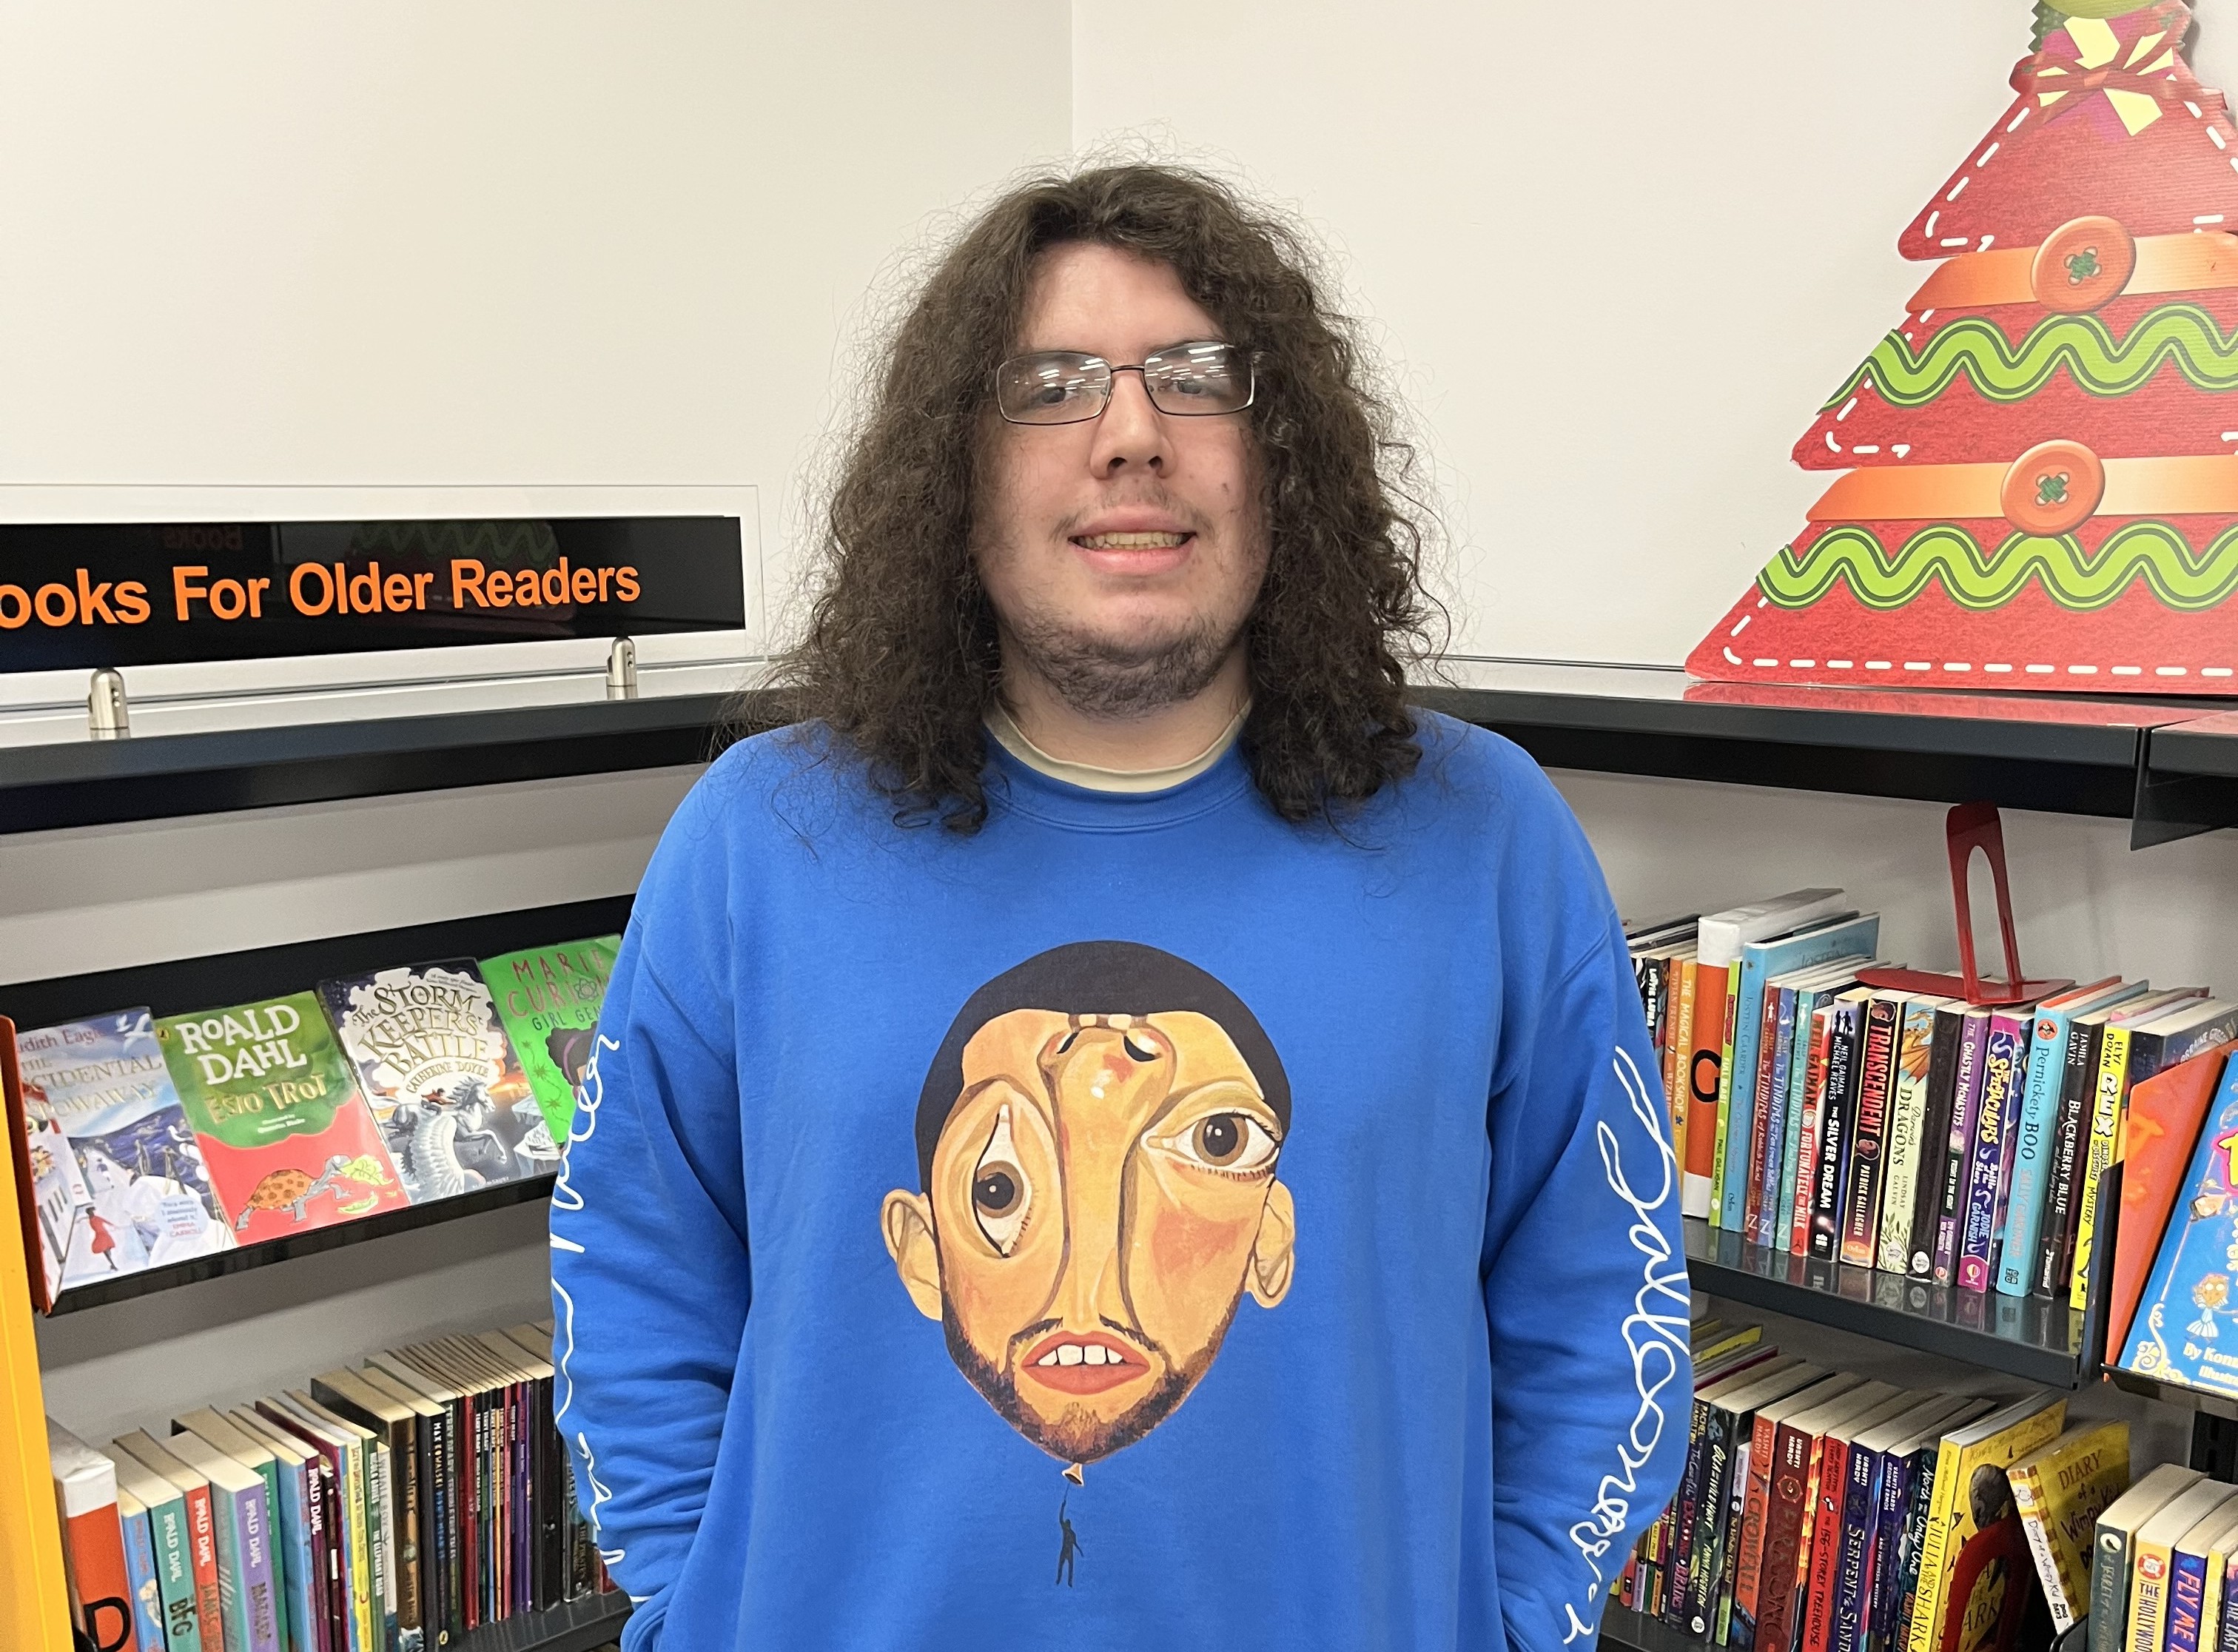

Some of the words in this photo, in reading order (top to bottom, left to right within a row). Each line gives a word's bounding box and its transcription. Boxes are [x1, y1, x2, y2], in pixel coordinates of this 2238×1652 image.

[173, 565, 269, 622] For
[292, 560, 435, 619] Older
[451, 557, 641, 609] Readers
[511, 948, 605, 982] MARIE
[1648, 969, 1658, 996] LOTTIE
[352, 1005, 381, 1027] The
[374, 982, 482, 1015] STORM
[1681, 979, 1691, 996] THE
[175, 1004, 300, 1055] ROALD
[531, 1011, 568, 1031] GIRL
[1647, 998, 1656, 1027] LUNA
[1678, 1003, 1690, 1047] MAGICAL
[1741, 996, 1754, 1031] JOSTEIN
[1810, 1019, 1823, 1050] NEIL
[1966, 1023, 1976, 1038] THE
[197, 1038, 309, 1086] DAHL
[382, 1032, 491, 1081] BATTLE
[1721, 1057, 1730, 1075] FULL
[1738, 1035, 1750, 1075] GAARDER
[1832, 1036, 1842, 1070] MICHAEL
[1840, 1044, 1848, 1062] NEIL
[1960, 1041, 1976, 1081] GHASTLY
[2067, 1031, 2080, 1066] GAVIN
[2077, 1032, 2089, 1067] JAMILA
[2102, 1032, 2114, 1067] DOLAN
[2113, 1041, 2123, 1065] ELYS
[406, 1061, 453, 1094] CATHERINE
[457, 1061, 489, 1078] DOYLE
[1674, 1054, 1687, 1112] BOOKSHOP
[1719, 1077, 1728, 1104] BLAST
[1804, 1053, 1821, 1106] GAIMAN
[1829, 1071, 1838, 1101] REAVES
[1837, 1064, 1846, 1095] GAIMAN
[1858, 1024, 1892, 1138] TRANSCENDENT
[2002, 1070, 2011, 1083] THE
[2024, 1047, 2050, 1120] Pernickety
[205, 1092, 264, 1124] ESIO
[263, 1073, 328, 1111] TROT
[1758, 1073, 1770, 1119] TINDIMS
[1771, 1077, 1784, 1123] TINDIMS
[1790, 1079, 1803, 1127] TINDIMS
[1980, 1054, 2010, 1145] SPECTACULARS
[2093, 1071, 2120, 1138] REX
[1824, 1118, 1839, 1161] SILVER
[1892, 1087, 1912, 1166] DRAGONS
[1909, 1106, 1922, 1146] Darwin's
[2020, 1122, 2040, 1161] BOO
[2059, 1099, 2082, 1181] BLACKBERRY
[1713, 1158, 1721, 1191] GILLIGAN
[1858, 1164, 1870, 1195] PATRICK
[1987, 1163, 1998, 1190] Battle
[2089, 1144, 2101, 1181] DISGUISE
[1820, 1164, 1835, 1209] DREAM
[1891, 1175, 1899, 1206] GALVIN
[1899, 1175, 1908, 1209] LINDSAY
[2054, 1182, 2069, 1215] BLUE
[1794, 1206, 1807, 1229] MILK
[1853, 1195, 1866, 1237] GALLAGHER
[1967, 1201, 1981, 1243] GARNISH
[2083, 1186, 2095, 1225] MYSTERY
[1978, 1210, 1991, 1239] JODIE
[2182, 1342, 2202, 1361] By
[433, 1422, 441, 1443] MAX
[446, 1405, 454, 1437] TERRY
[1689, 1403, 1700, 1446] HAMILTON
[1697, 1405, 1707, 1437] RACHEL
[1753, 1424, 1764, 1455] HARDY
[1761, 1427, 1771, 1459] VASHTI
[1785, 1434, 1795, 1465] HARDY
[1793, 1437, 1803, 1469] VASHTI
[378, 1459, 388, 1499] WHALE
[434, 1443, 443, 1488] KOWALSKI
[1853, 1453, 1863, 1483] HARDY
[1860, 1456, 1870, 1487] VASHTI
[1885, 1462, 1893, 1488] GEORGE
[1919, 1465, 1935, 1501] North
[2058, 1448, 2103, 1491] DIARY
[308, 1468, 320, 1502] ROALD
[1707, 1478, 1720, 1501] WILD
[163, 1512, 179, 1549] ROALD
[194, 1498, 209, 1534] ROALD
[244, 1499, 259, 1535] ROALD
[310, 1505, 321, 1535] DAHL
[1703, 1502, 1717, 1534] HUNT
[1908, 1514, 1929, 1550] Only
[198, 1536, 211, 1567] DAHL
[248, 1537, 262, 1568] DAHL
[1701, 1543, 1713, 1569] ANNA
[1739, 1497, 1761, 1594] CROWFALL
[1817, 1528, 1832, 1588] 156-STOREY
[1842, 1523, 1866, 1598] SERPENT
[1909, 1550, 1921, 1576] One
[1923, 1524, 1944, 1571] JULIA
[168, 1551, 183, 1582] DAHL
[1671, 1563, 1689, 1611] BRAINS
[2139, 1582, 2160, 1598] THE
[2175, 1569, 2202, 1608] FLY
[83, 1596, 132, 1652] D
[167, 1597, 194, 1637] BFG
[1809, 1590, 1825, 1647] TREEHOUSE
[1909, 1585, 1934, 1648] SHARK
[2172, 1607, 2197, 1642] ME
[2226, 1601, 2238, 1621] THE
[2223, 1623, 2238, 1651] LAST
